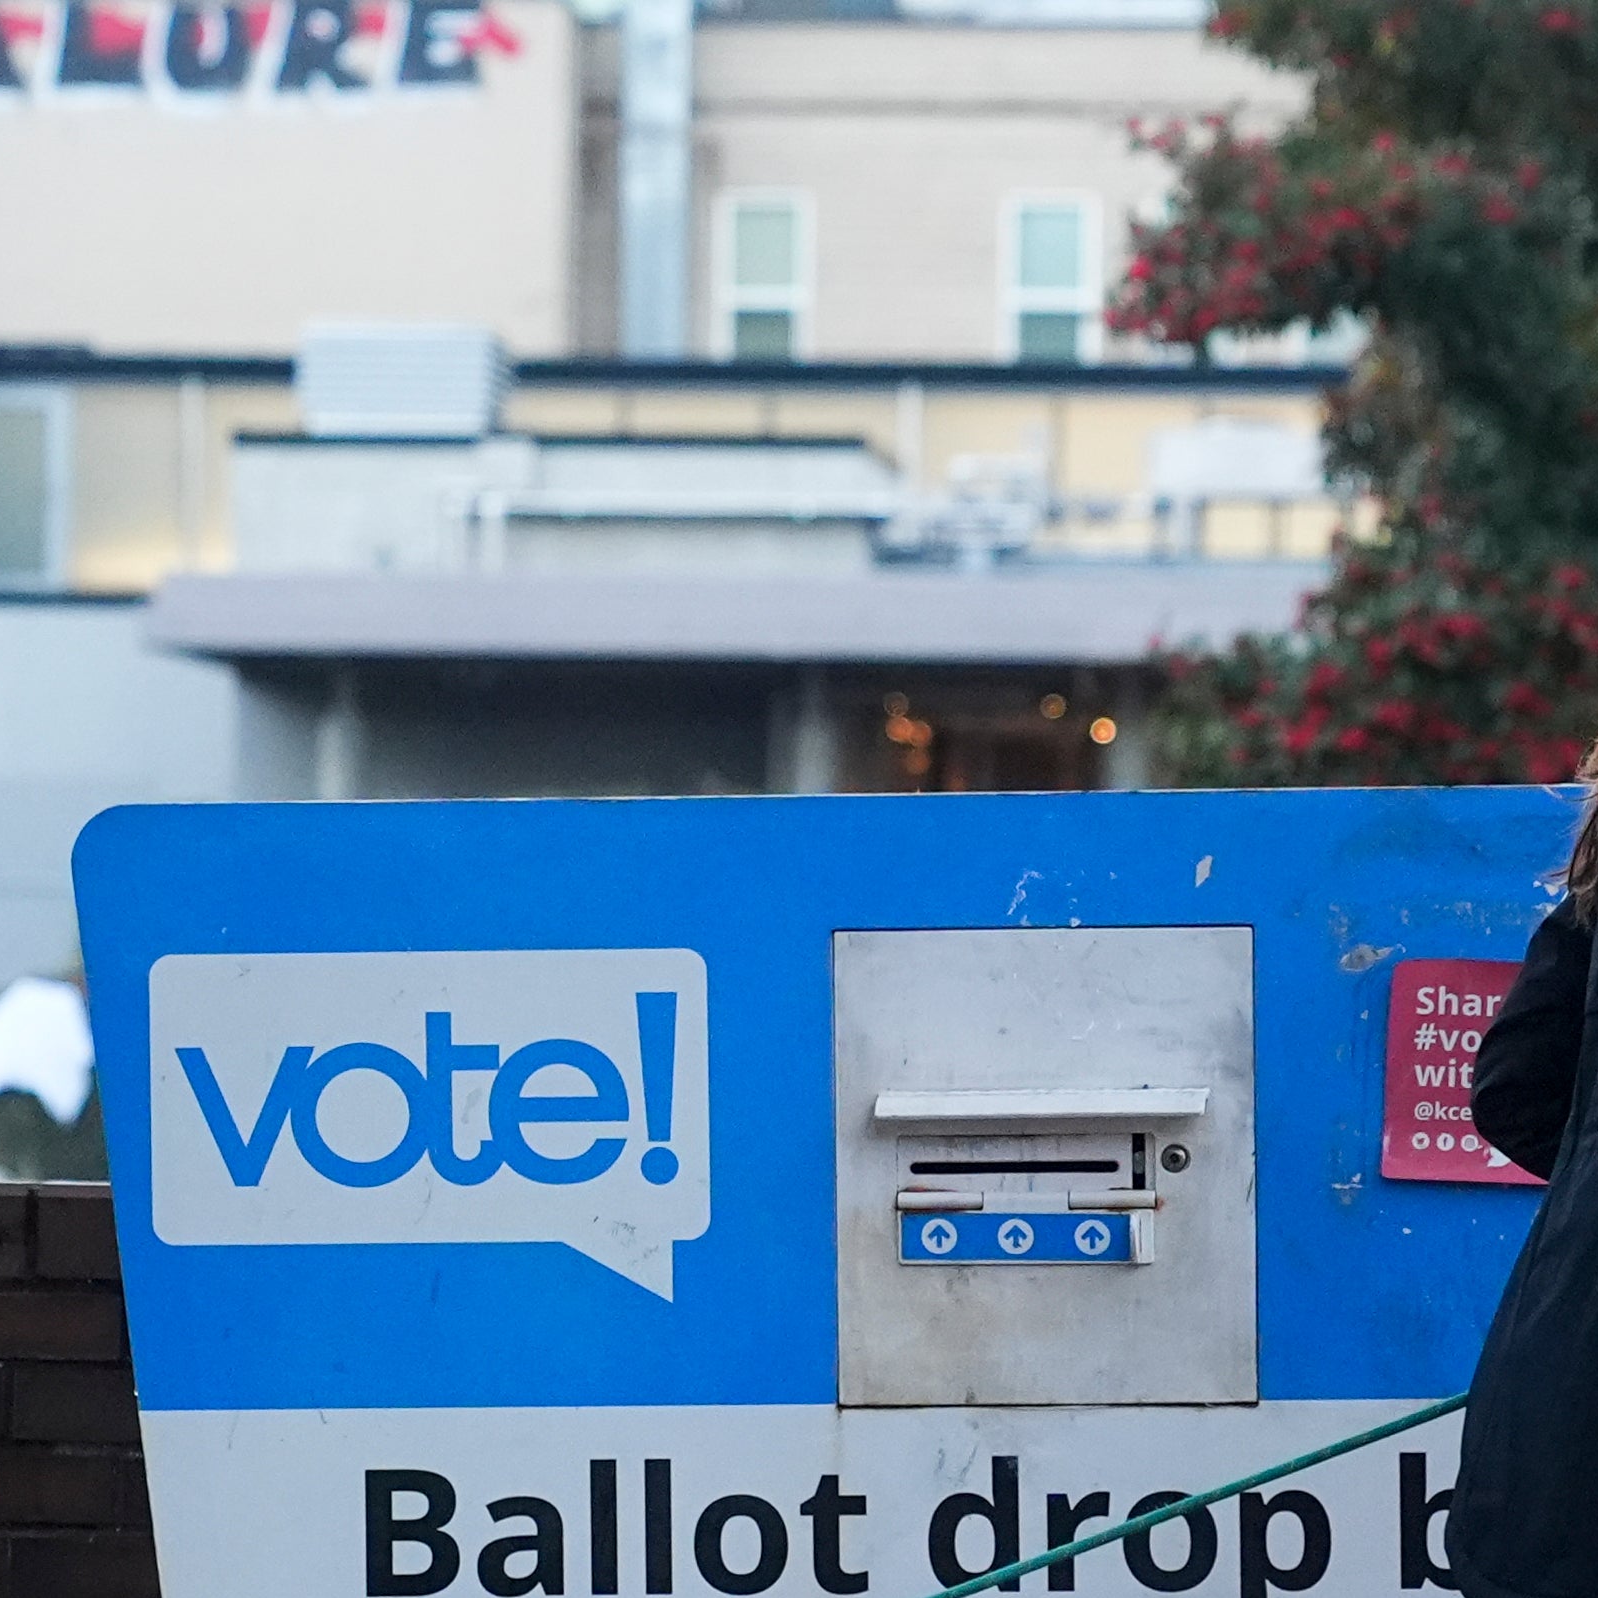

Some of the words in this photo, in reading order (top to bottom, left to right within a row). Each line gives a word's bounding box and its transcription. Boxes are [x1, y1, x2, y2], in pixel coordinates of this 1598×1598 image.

[1415, 985, 1502, 1018] Shar
[1413, 1022, 1483, 1053] #vo
[174, 991, 680, 1188] vote!
[1414, 1058, 1475, 1089] wit
[1413, 1100, 1473, 1121] @kce
[365, 1458, 869, 1598] Ballot
